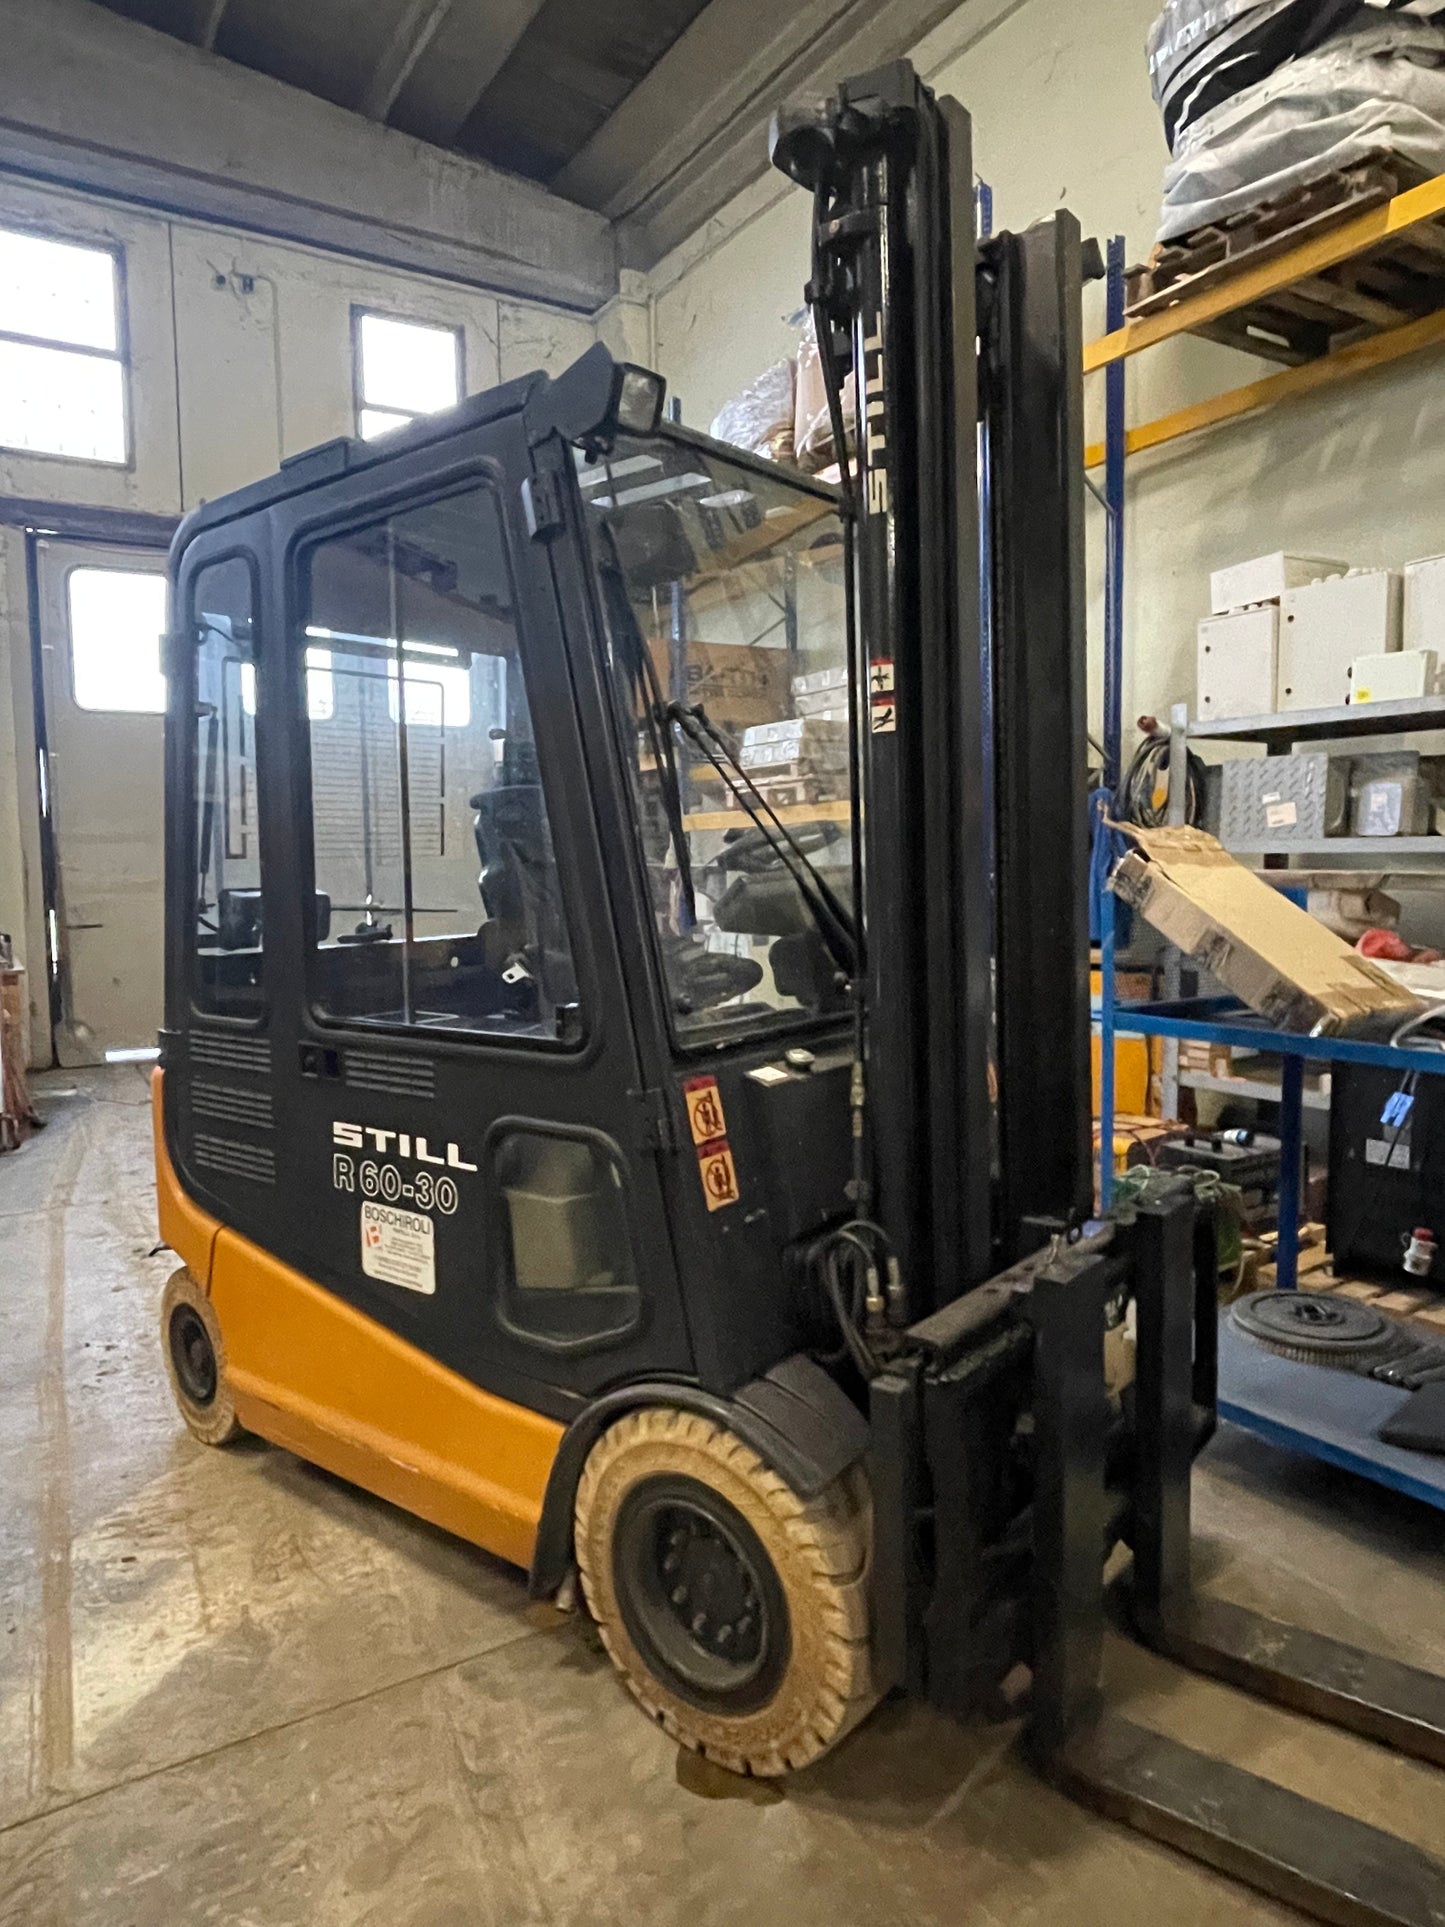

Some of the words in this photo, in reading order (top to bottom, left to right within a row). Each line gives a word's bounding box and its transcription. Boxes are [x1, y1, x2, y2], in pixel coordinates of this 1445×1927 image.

[864, 311, 888, 514] STILL
[333, 1121, 478, 1172] STILL
[333, 1153, 355, 1192] R
[359, 1160, 459, 1215] 60-30
